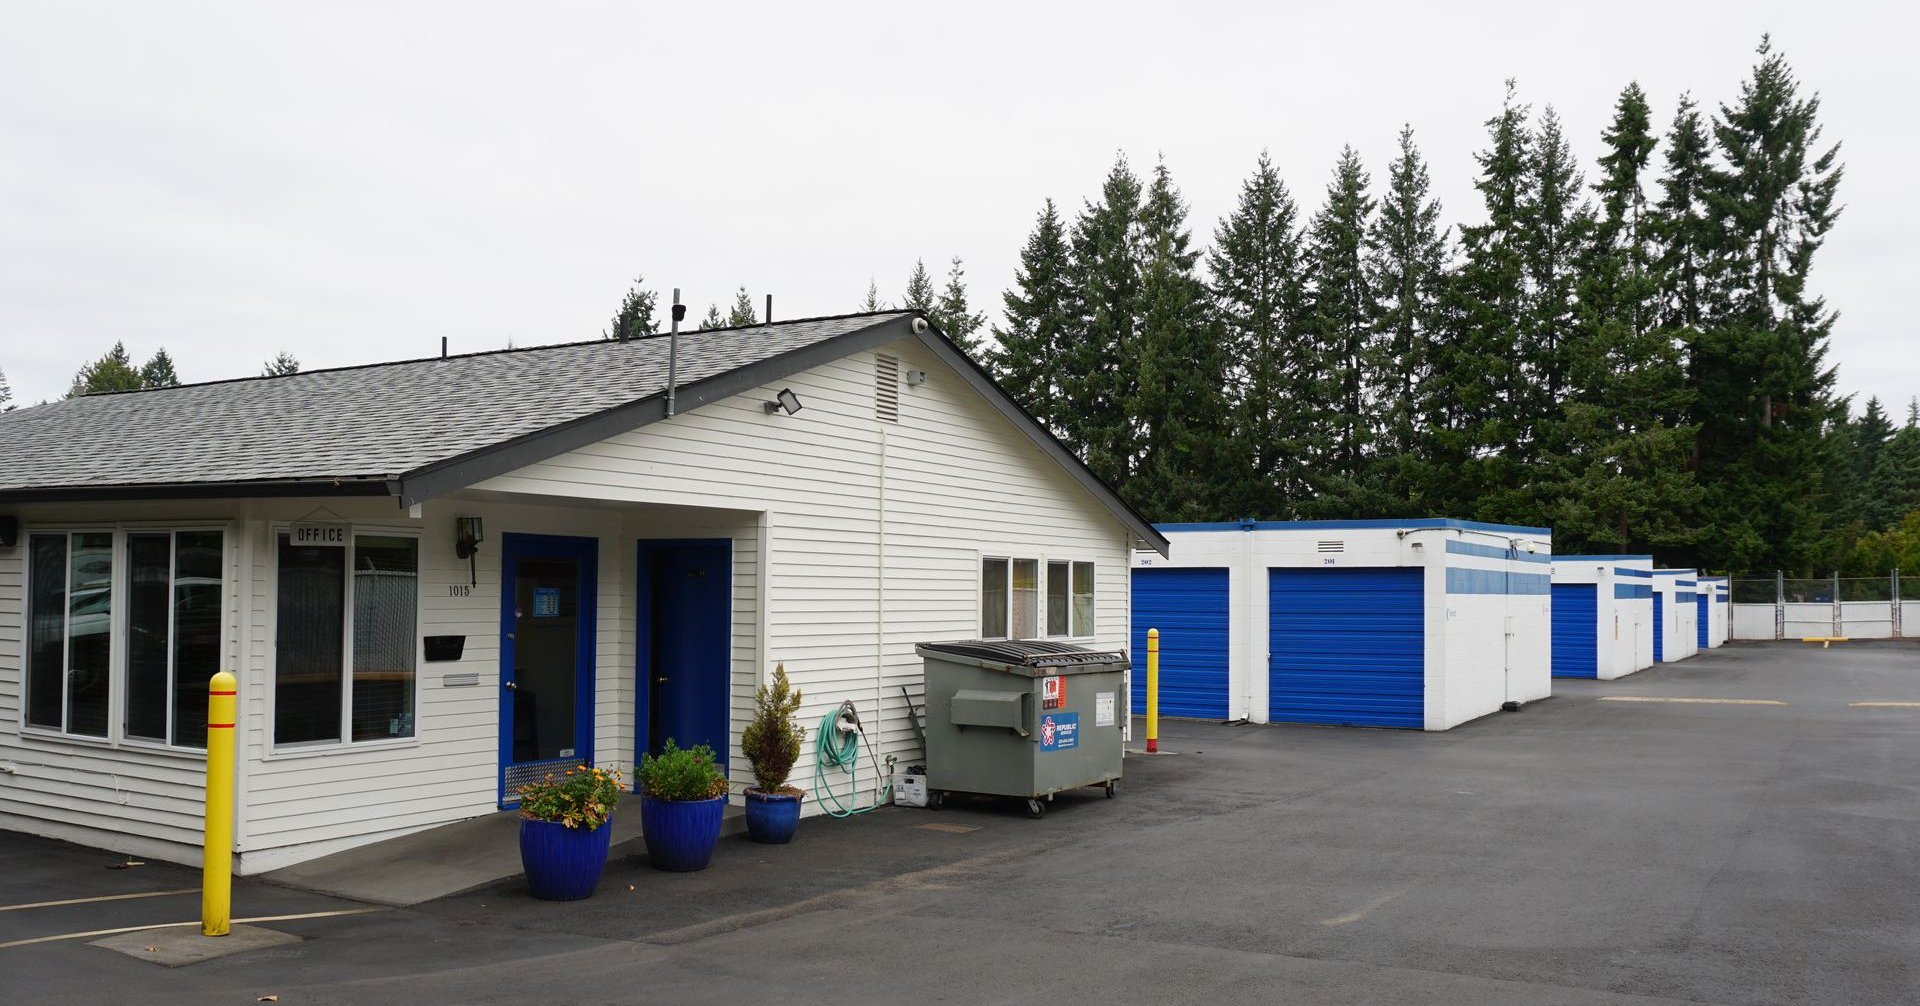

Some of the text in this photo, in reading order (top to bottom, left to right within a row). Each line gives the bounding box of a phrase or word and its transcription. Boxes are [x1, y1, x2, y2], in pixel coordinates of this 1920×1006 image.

[298, 528, 342, 541] OFFICE
[449, 585, 470, 597] 1015
[1056, 723, 1077, 731] REPUBLIC
